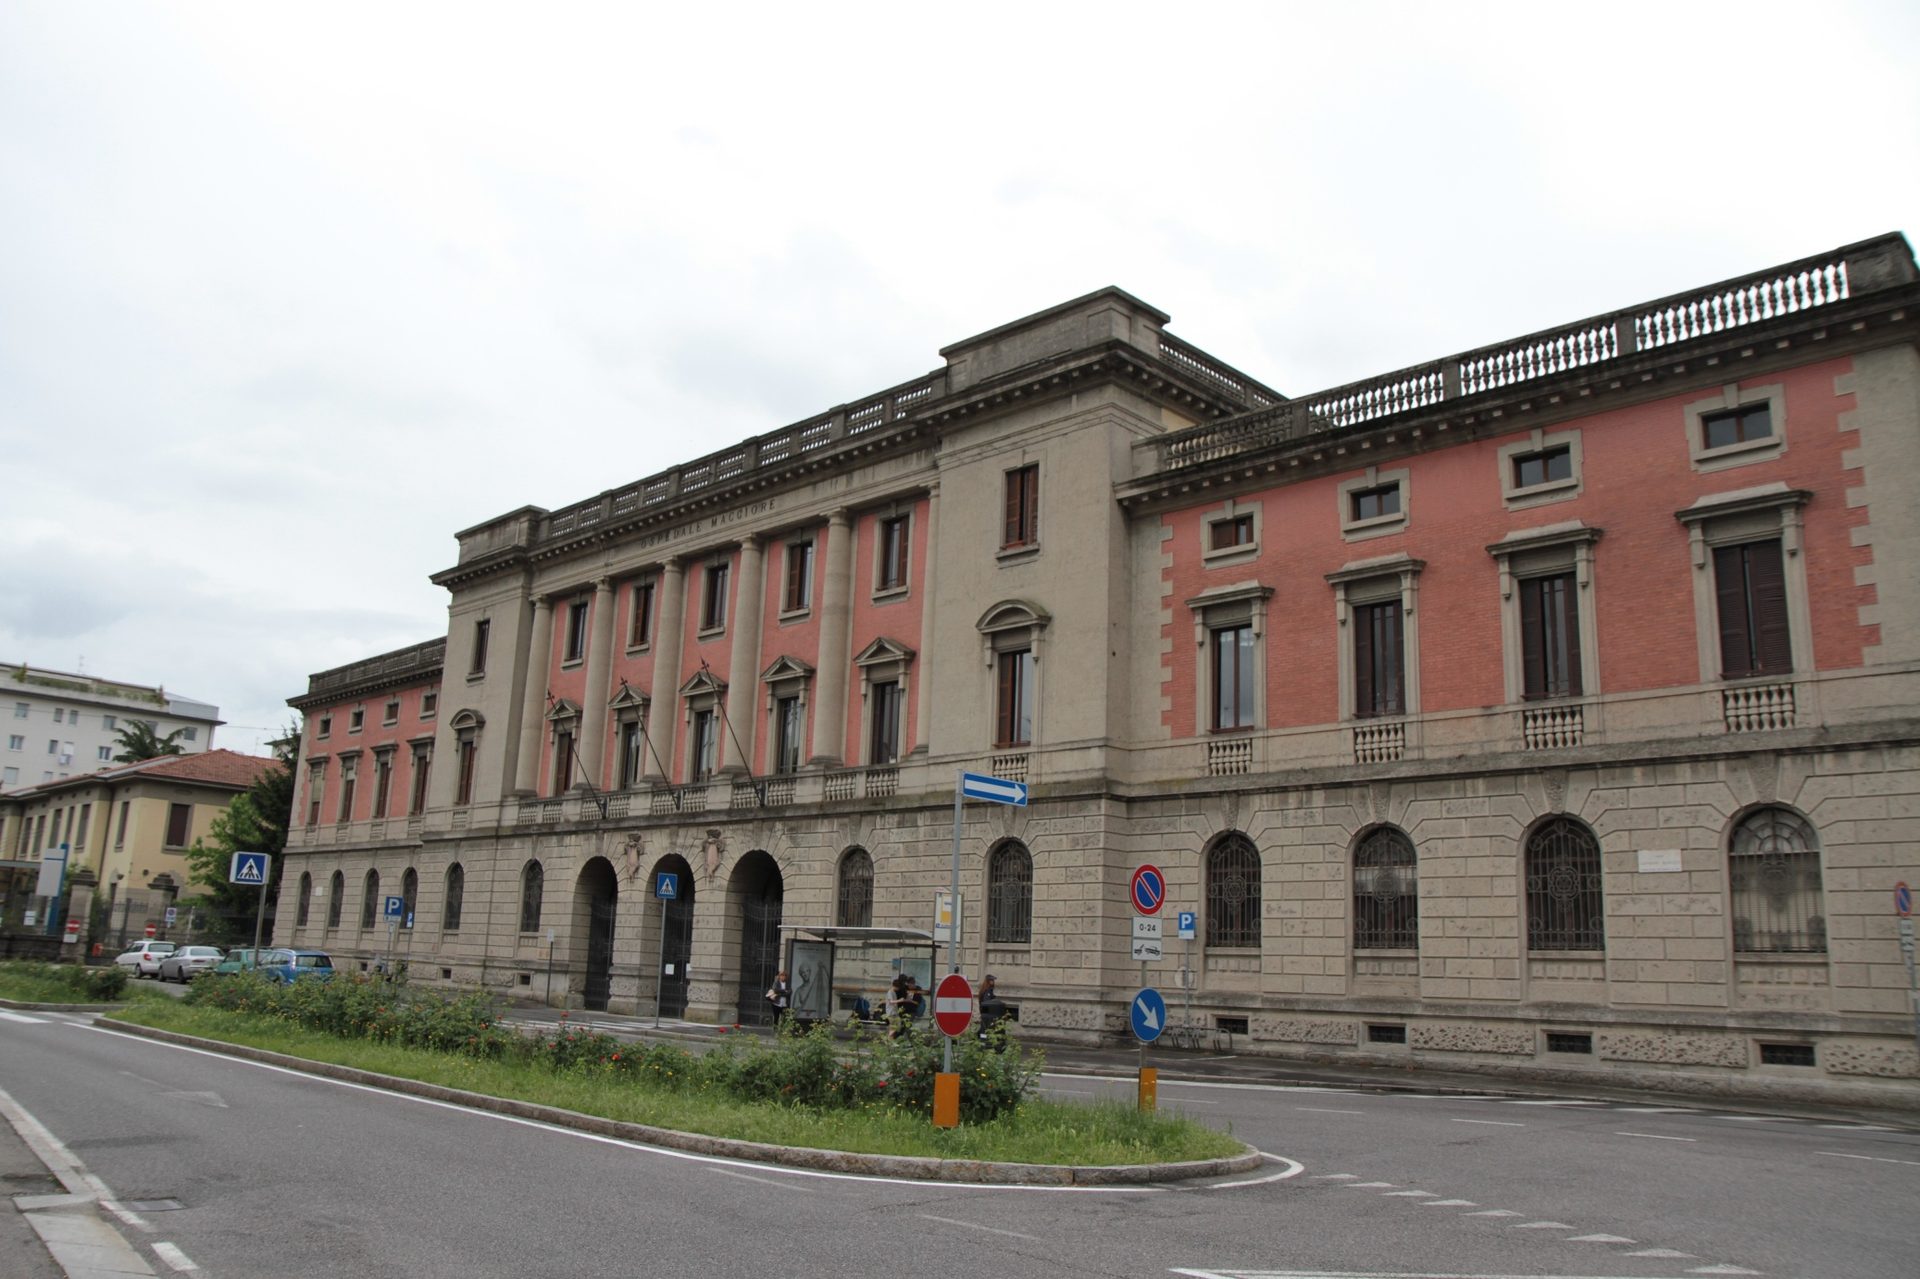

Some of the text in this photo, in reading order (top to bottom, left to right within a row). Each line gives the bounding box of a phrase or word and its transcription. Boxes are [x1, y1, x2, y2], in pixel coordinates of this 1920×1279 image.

[641, 500, 776, 549] OSPEDALE MAGGIORE
[388, 898, 400, 913] P
[1139, 923, 1156, 932] 0-24
[1181, 914, 1192, 928] P
